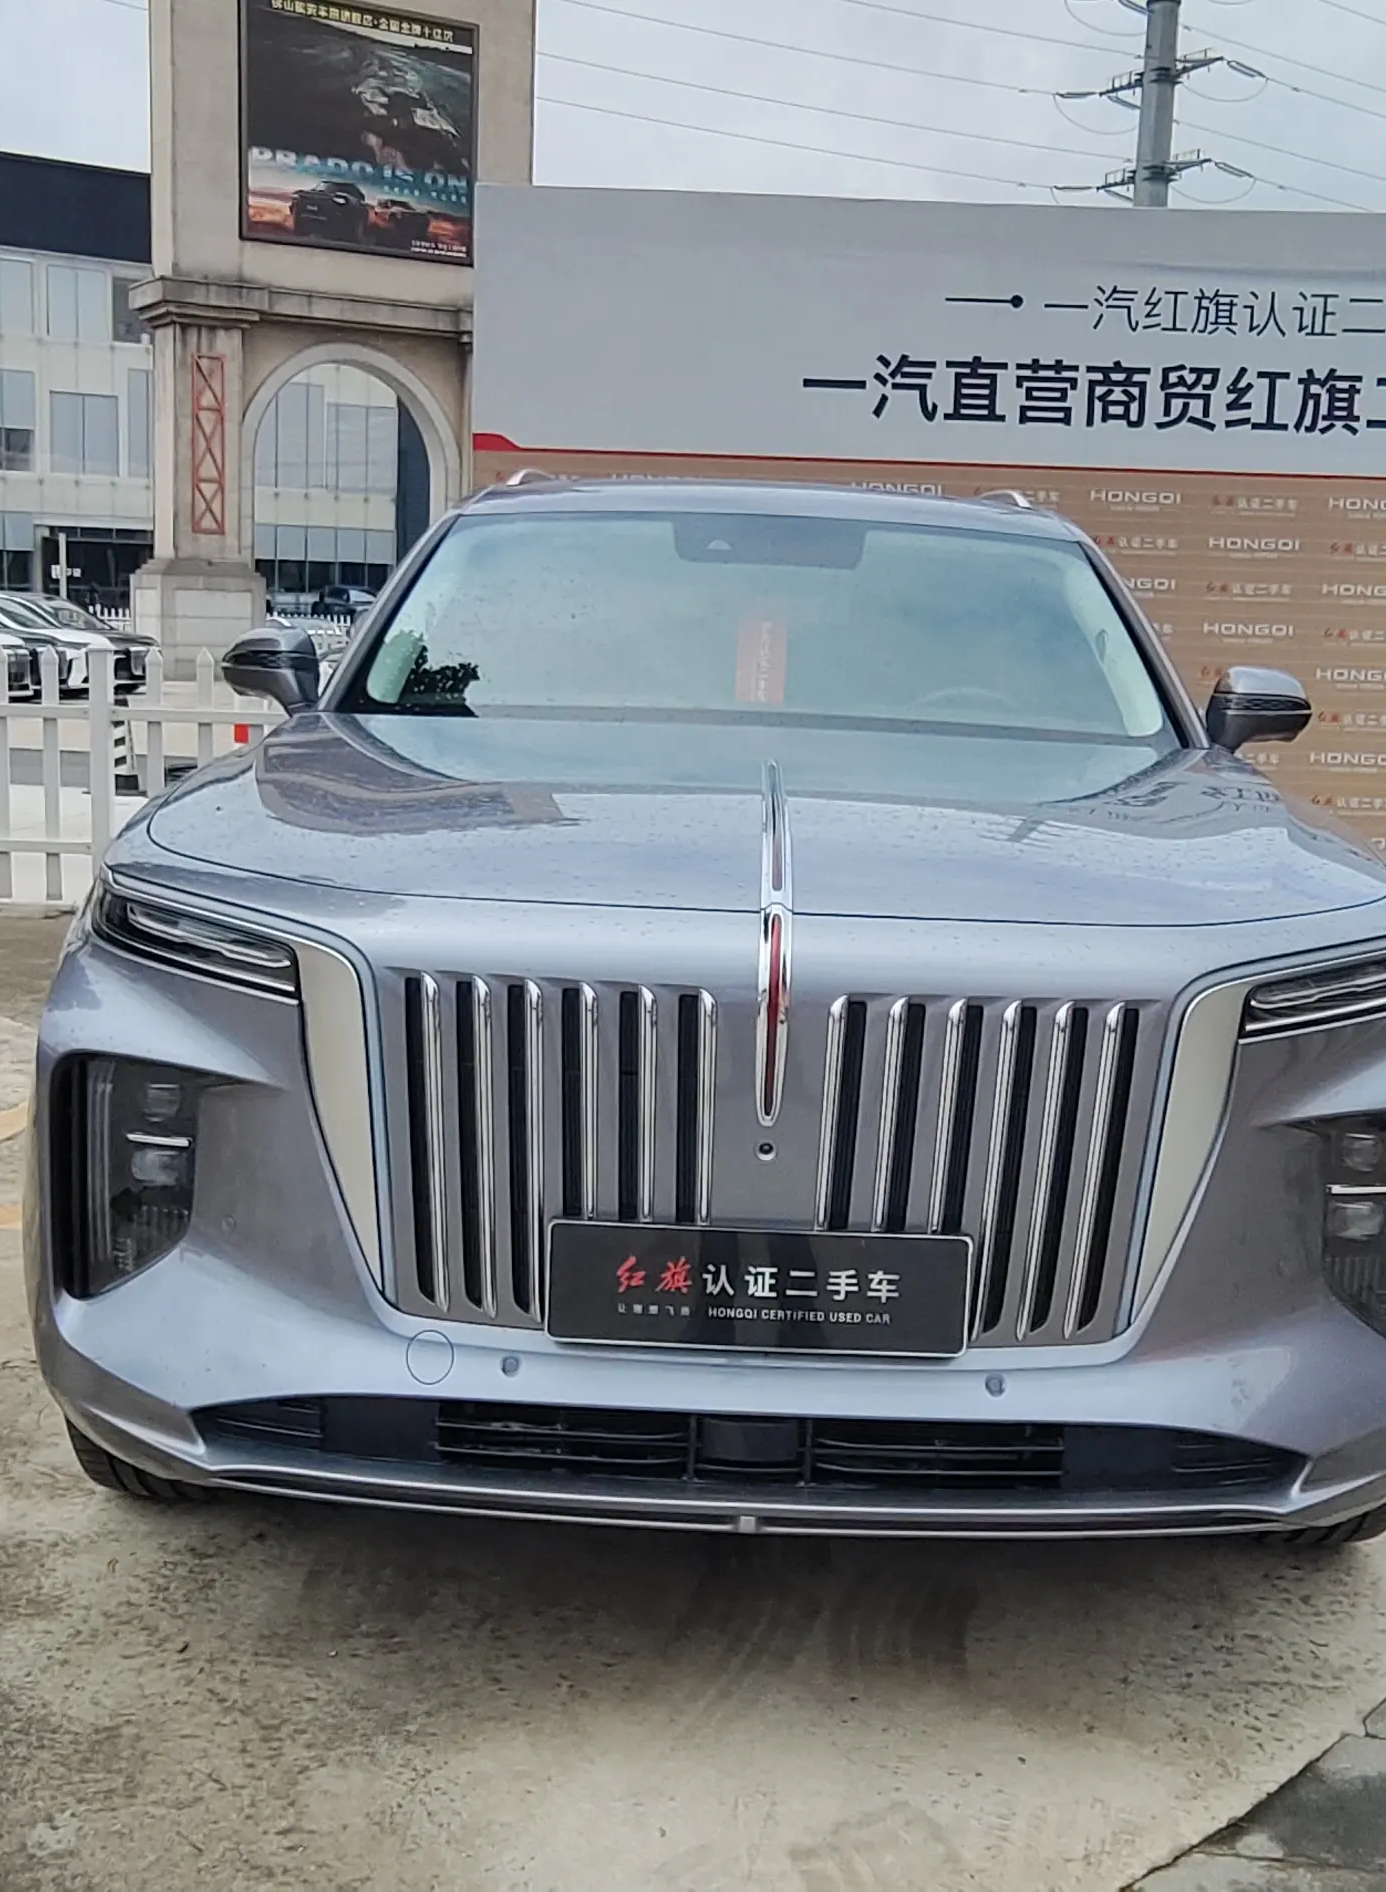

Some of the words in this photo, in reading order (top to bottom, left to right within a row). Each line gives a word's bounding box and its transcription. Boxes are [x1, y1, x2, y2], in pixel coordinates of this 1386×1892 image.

[248, 145, 374, 179] PRADO
[708, 1307, 758, 1320] HONGQI
[761, 1309, 825, 1322] CERTIFIED
[829, 1312, 862, 1324] USED
[865, 1313, 891, 1326] CAR
